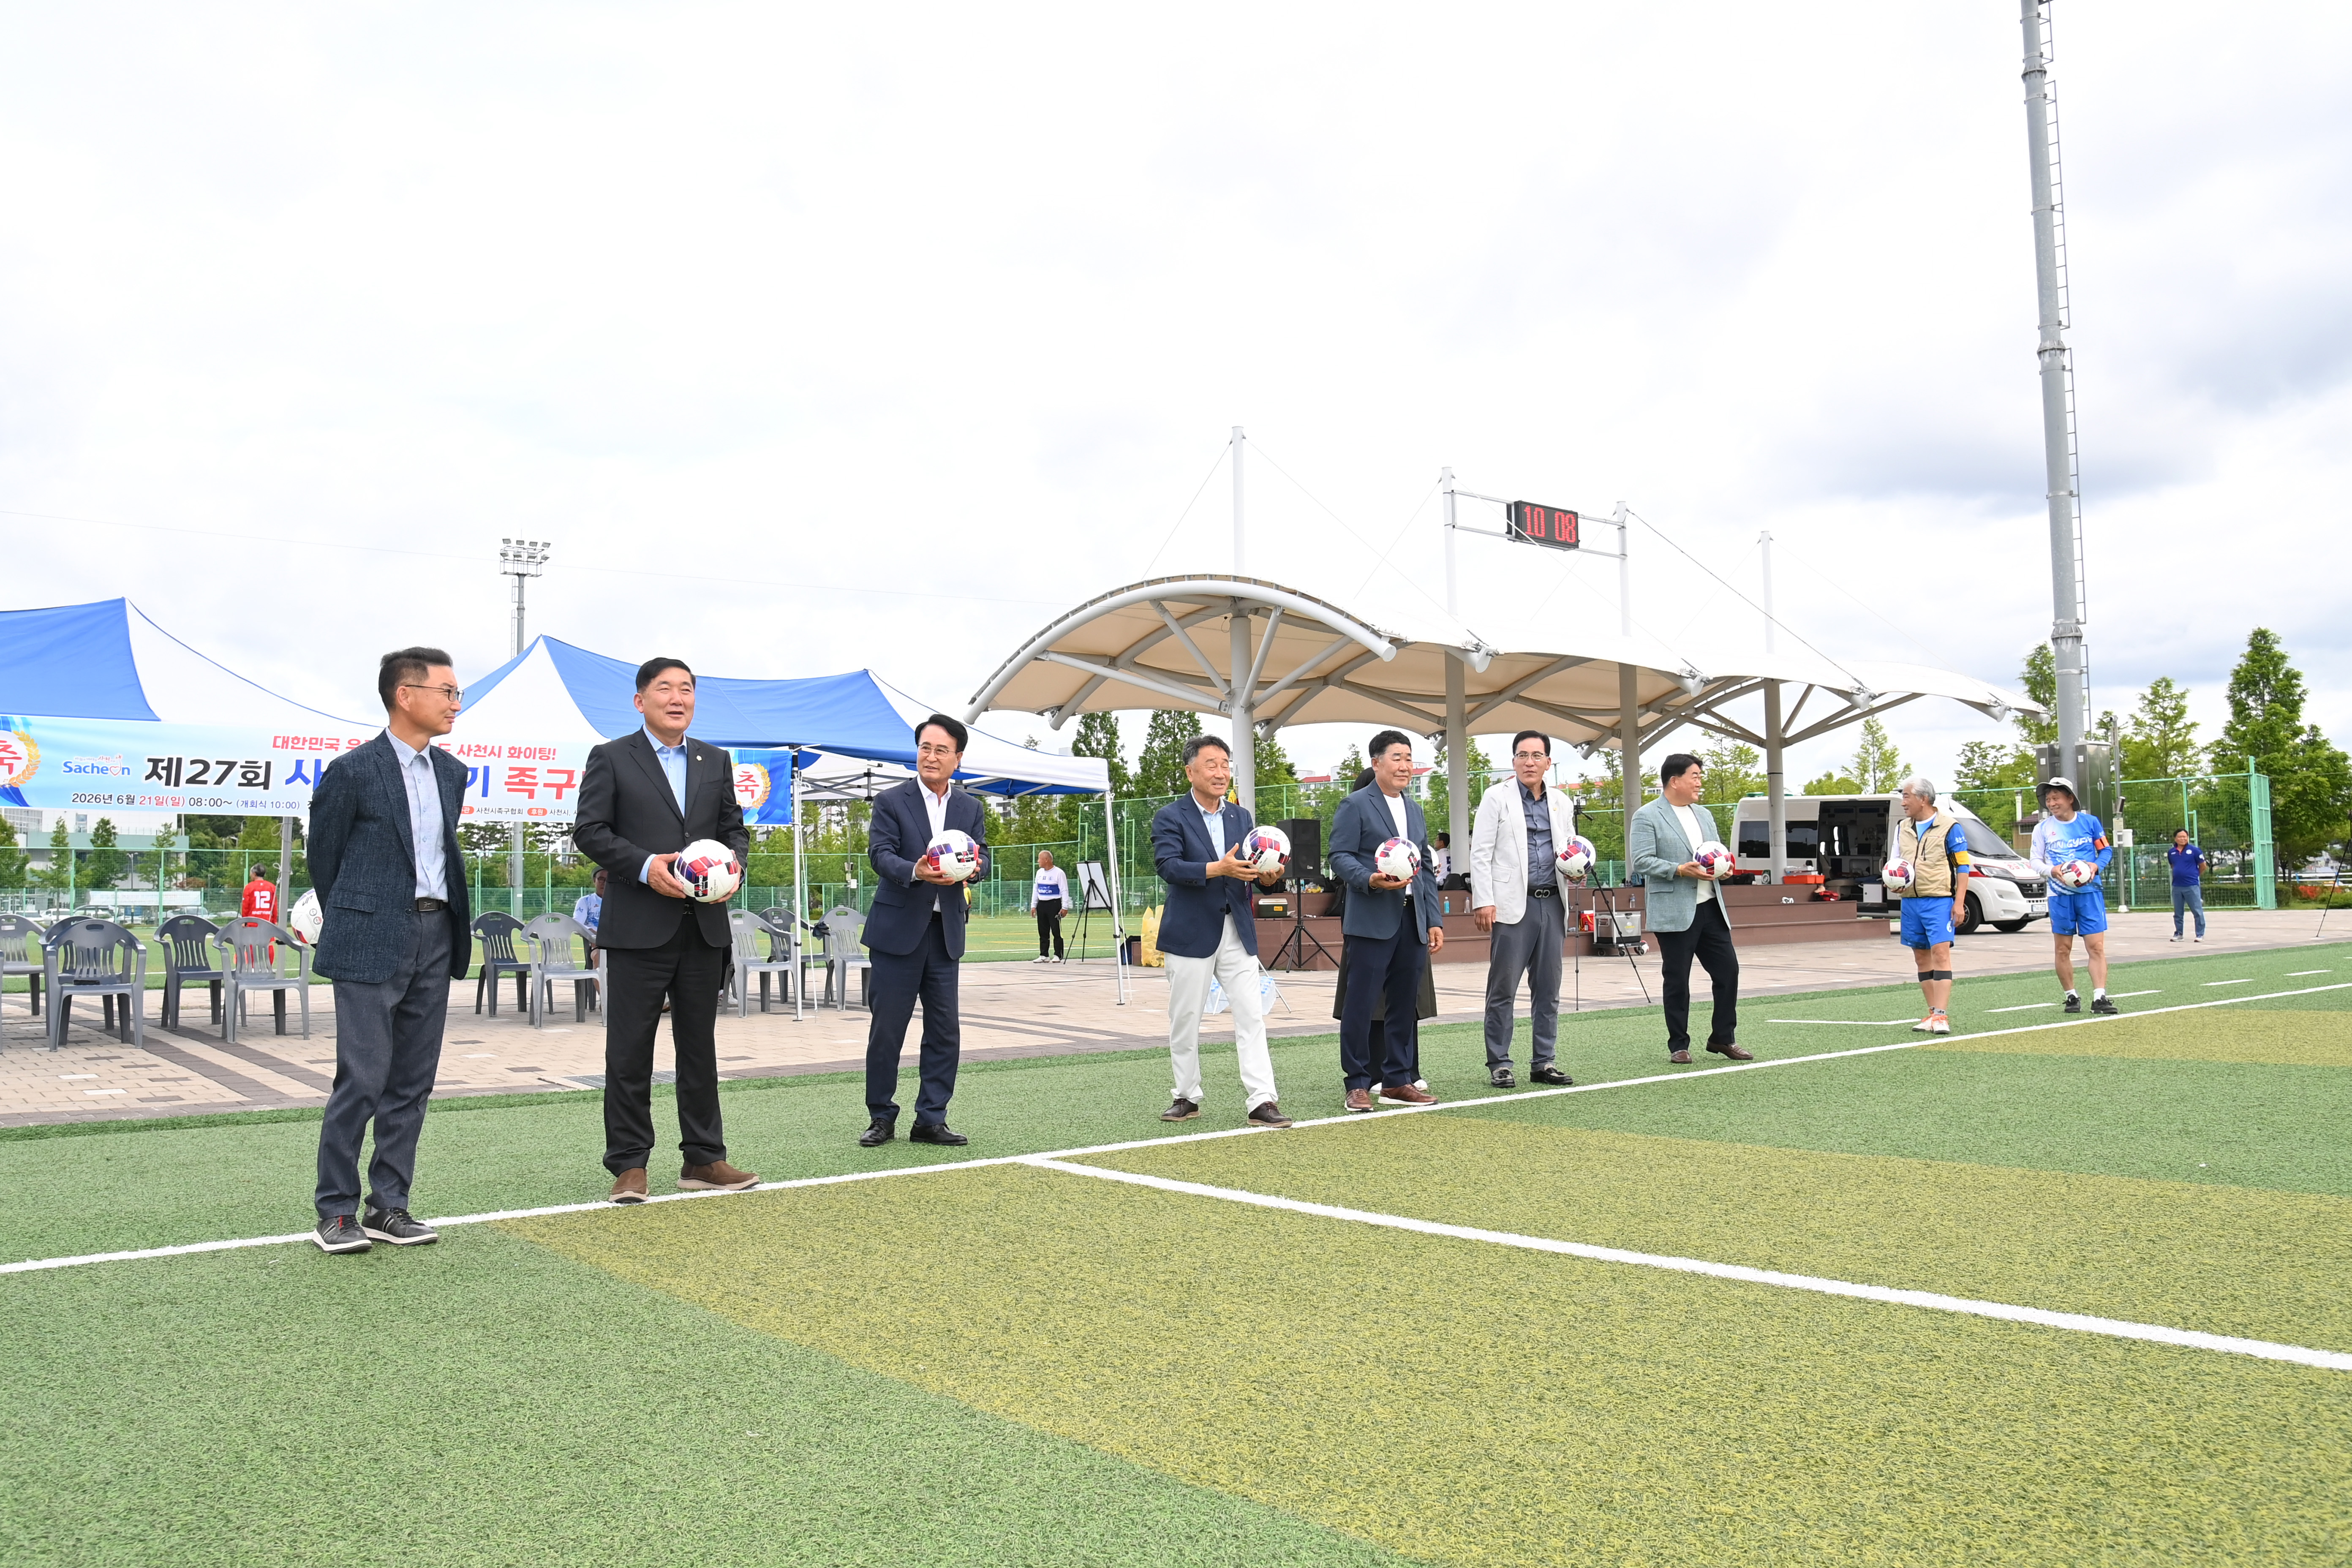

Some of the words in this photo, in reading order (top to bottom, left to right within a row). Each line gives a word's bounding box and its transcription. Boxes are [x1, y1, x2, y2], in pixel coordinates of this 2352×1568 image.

[1524, 506, 1545, 537] 10
[1554, 512, 1576, 542] 08
[272, 736, 340, 751] 대한민국
[457, 744, 502, 758] 사천시
[507, 746, 556, 760] 화이팅!
[145, 757, 271, 790] 제27회
[505, 767, 586, 800] 족구
[734, 771, 760, 799] 축
[72, 793, 112, 804] 2026년
[117, 795, 135, 805] 6월
[139, 795, 185, 807] 21일(일)
[189, 798, 232, 807] 08:00~
[237, 799, 267, 808] (개회식
[271, 801, 300, 810] 10:00)
[254, 891, 270, 909] 12
